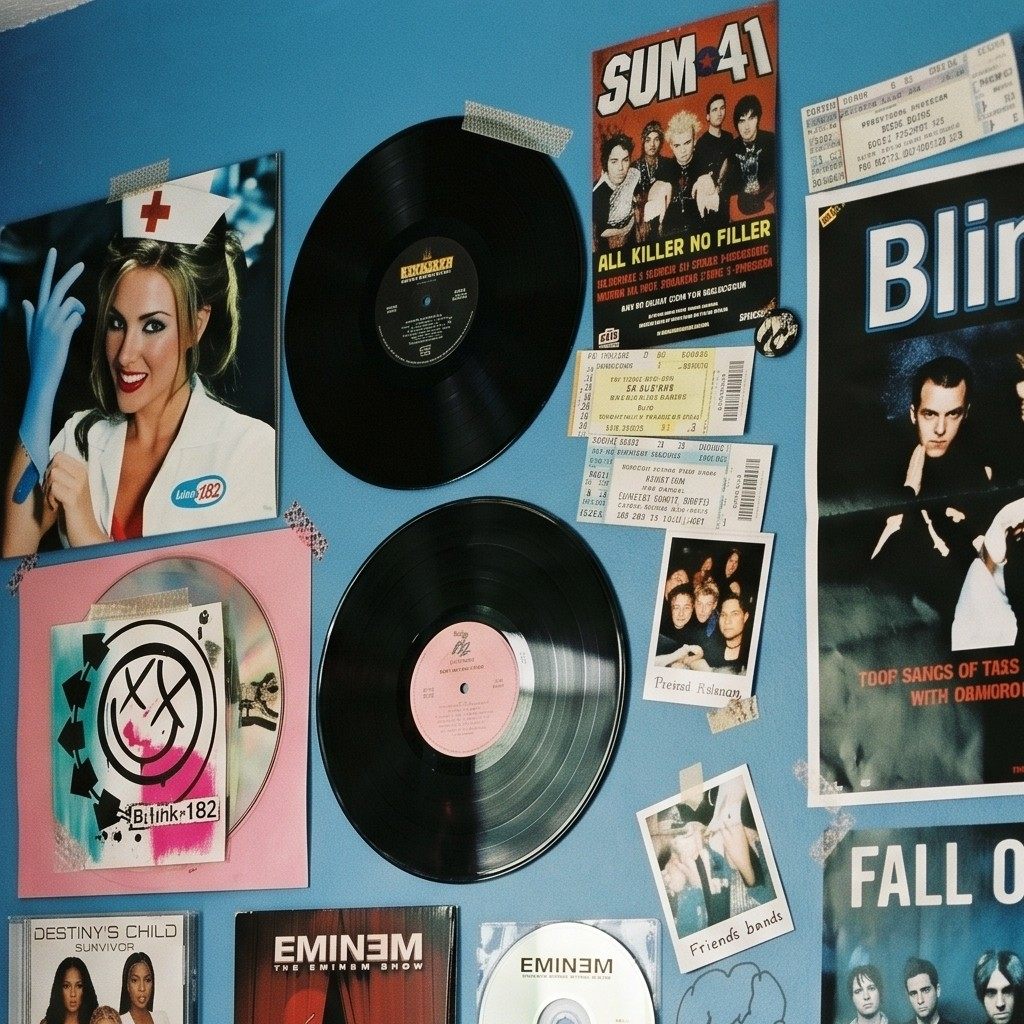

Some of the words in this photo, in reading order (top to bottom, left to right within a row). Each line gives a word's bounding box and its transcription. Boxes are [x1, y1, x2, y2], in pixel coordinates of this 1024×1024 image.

[597, 33, 697, 117] SUM
[717, 16, 773, 83] 41
[598, 250, 626, 272] ALL
[632, 238, 684, 265] KILLER
[690, 232, 711, 253] NO
[717, 219, 771, 247] FILLER
[198, 482, 221, 501] 182
[958, 661, 978, 679] OF
[851, 842, 973, 908] FALL
[33, 925, 119, 941] DESTINY'S
[125, 923, 177, 940] CHILD
[689, 927, 741, 957] Friends
[746, 911, 784, 936] bands
